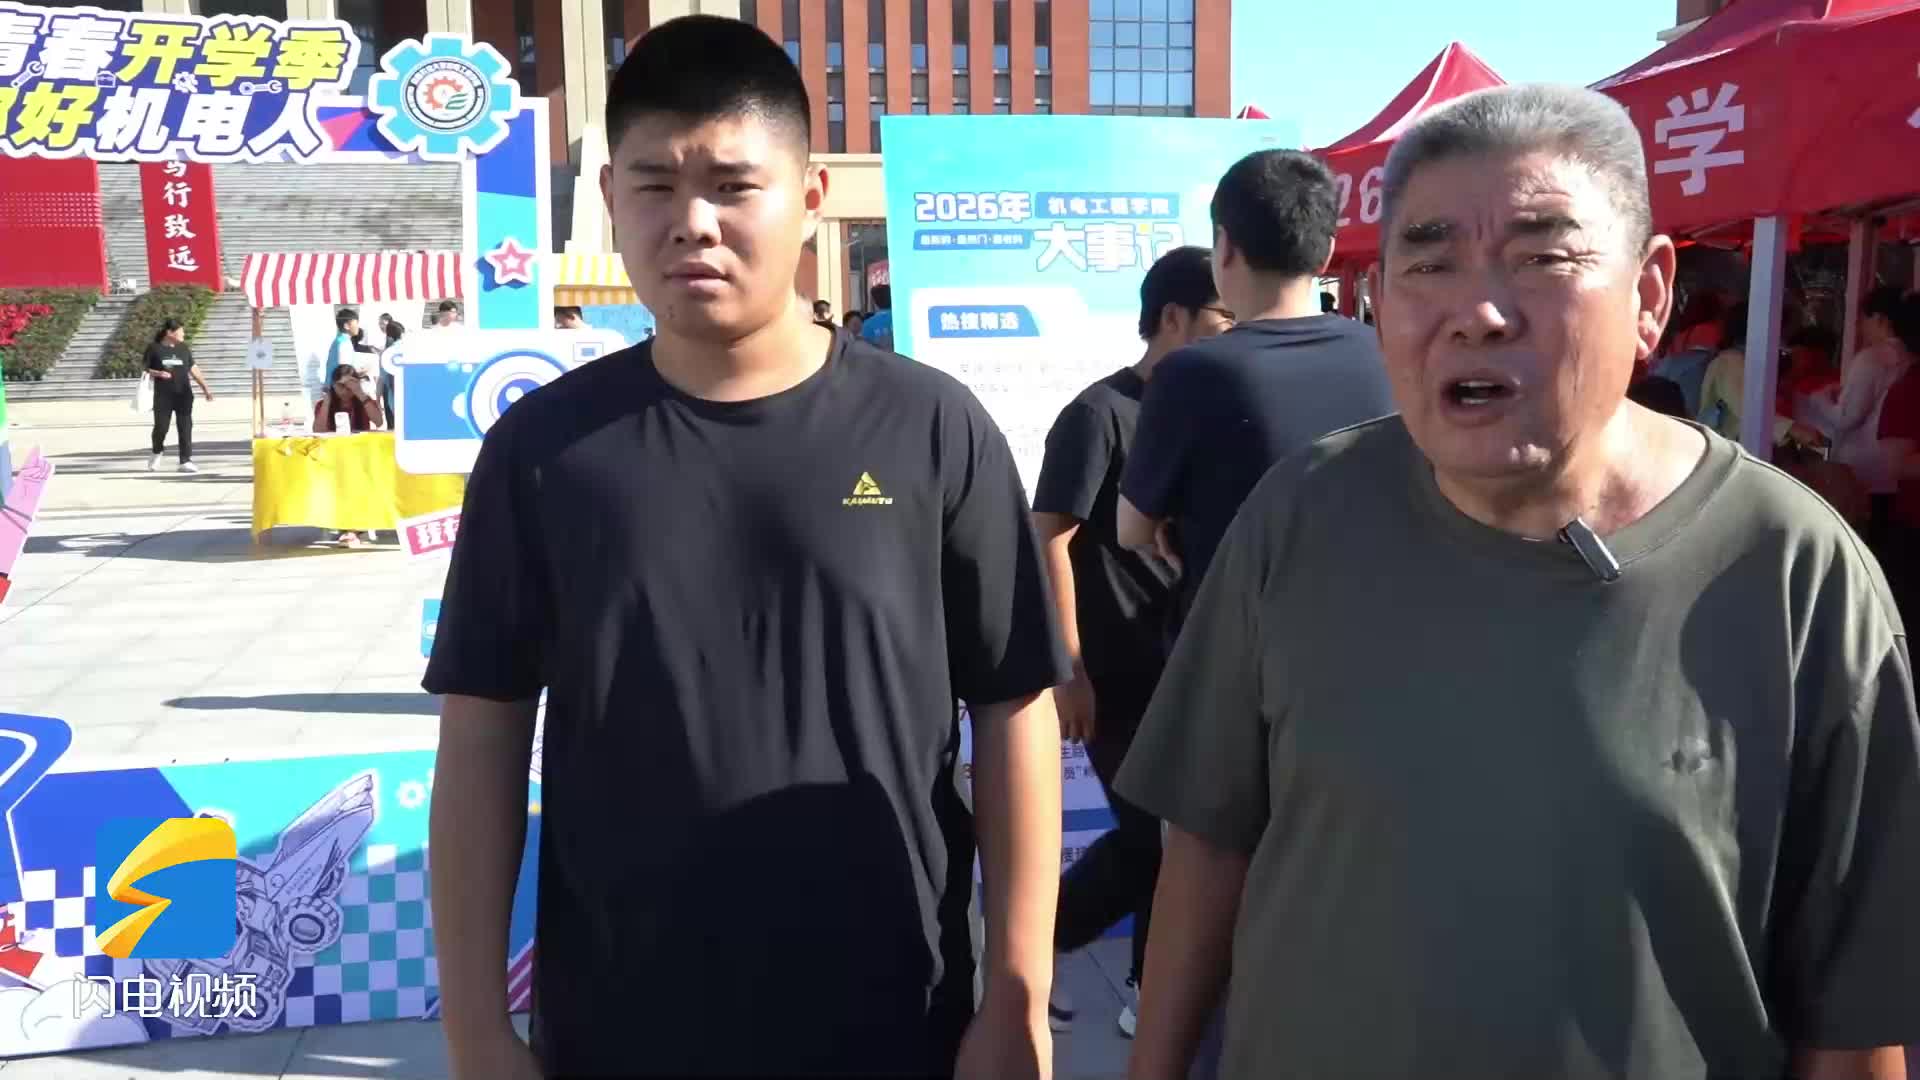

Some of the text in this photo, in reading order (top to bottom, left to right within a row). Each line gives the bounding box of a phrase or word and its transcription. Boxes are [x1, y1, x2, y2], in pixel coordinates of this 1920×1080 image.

[0, 82, 321, 157] 好机电人
[914, 190, 1031, 223] 2026年
[1047, 196, 1170, 216] 机电工程学院
[1033, 221, 1185, 273] 大事记
